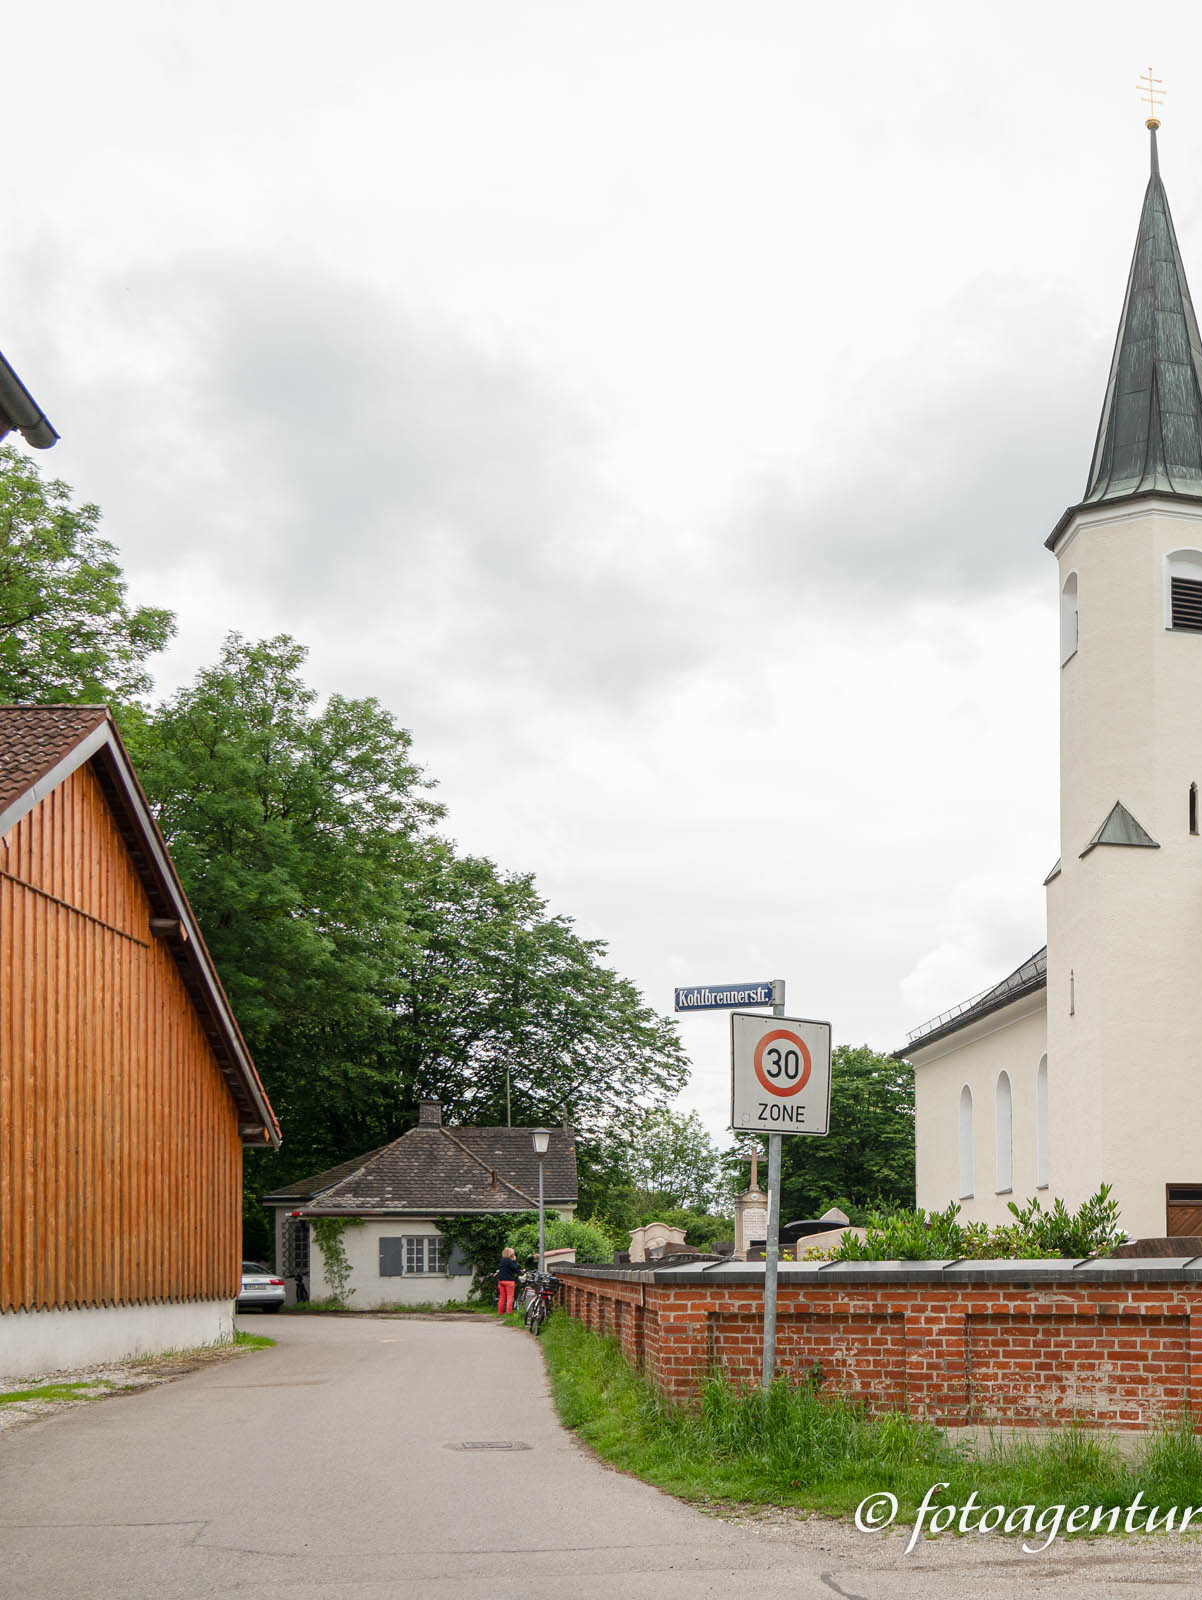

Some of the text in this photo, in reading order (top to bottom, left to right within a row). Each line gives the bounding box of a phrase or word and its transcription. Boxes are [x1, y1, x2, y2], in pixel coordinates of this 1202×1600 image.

[679, 988, 769, 1007] Kohlbrennerstr.
[766, 1048, 799, 1080] 30
[758, 1103, 806, 1123] ZONE
